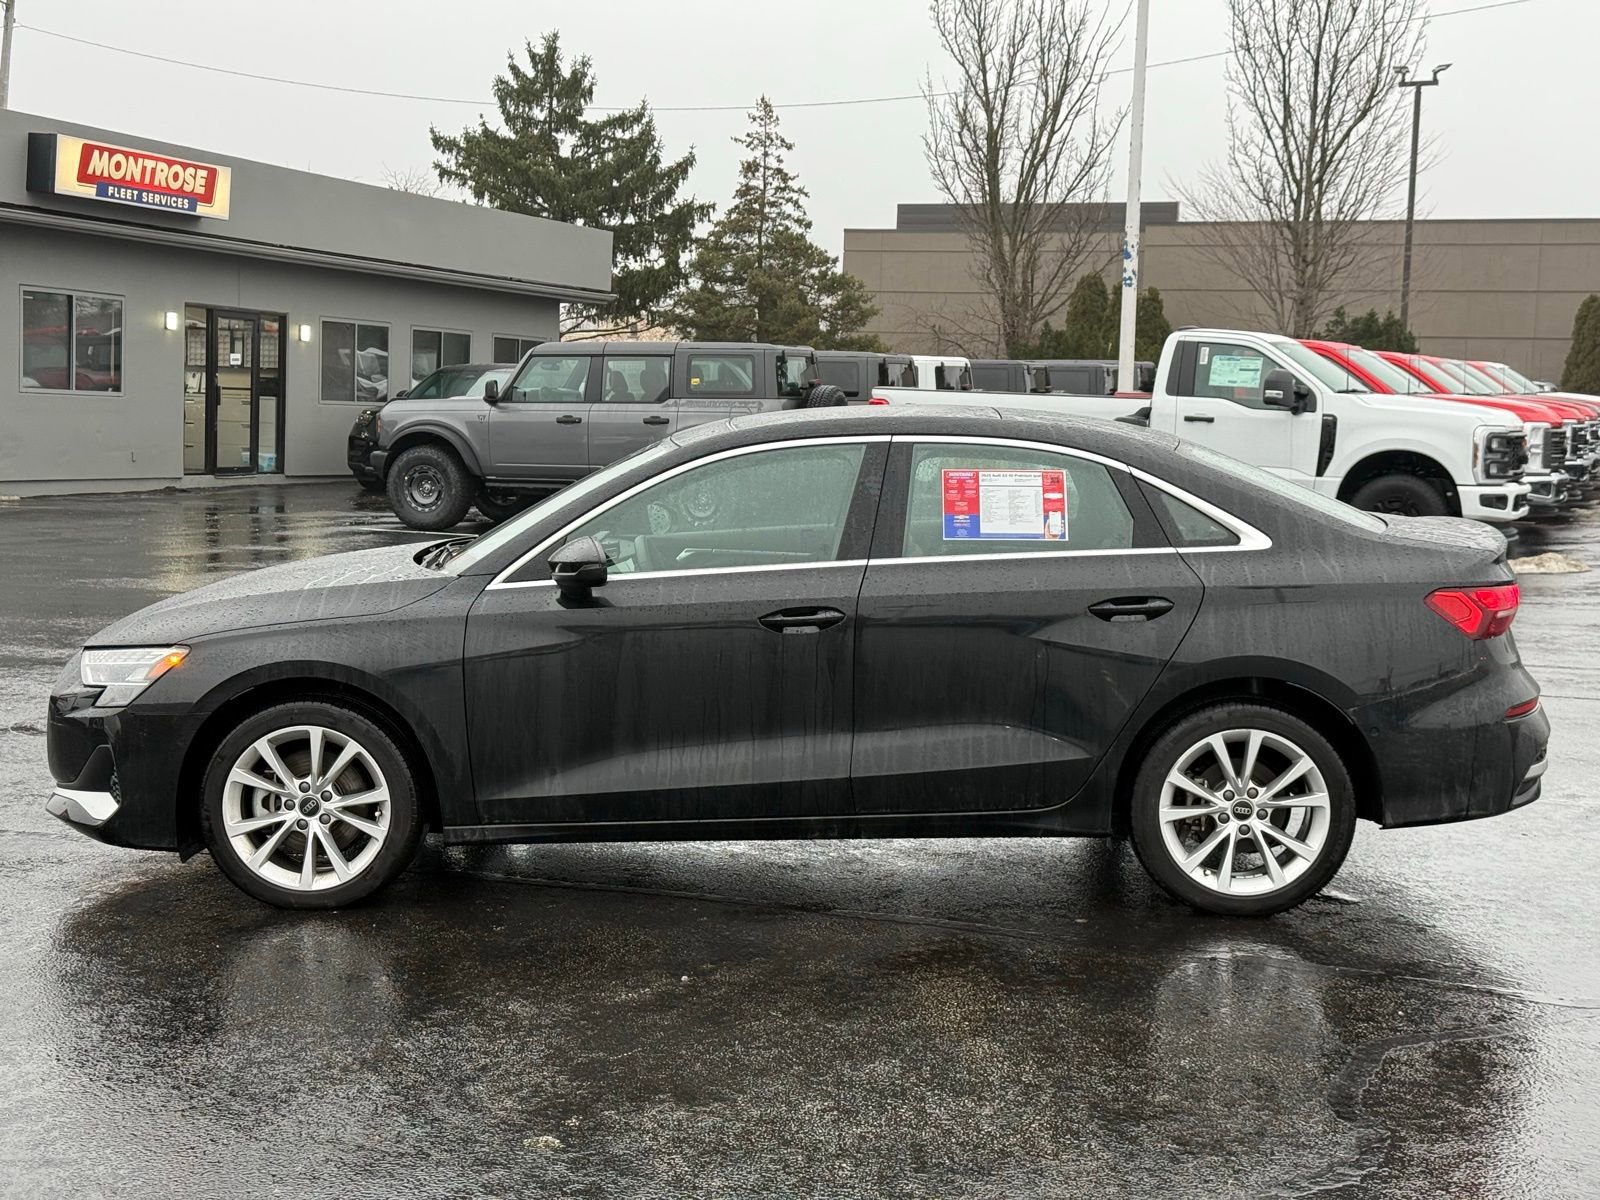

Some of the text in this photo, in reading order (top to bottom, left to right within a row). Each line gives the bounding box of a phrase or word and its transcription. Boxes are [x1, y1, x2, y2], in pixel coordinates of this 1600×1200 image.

[87, 149, 208, 195] MONTROSE
[108, 186, 189, 209] FLEET SERVICES
